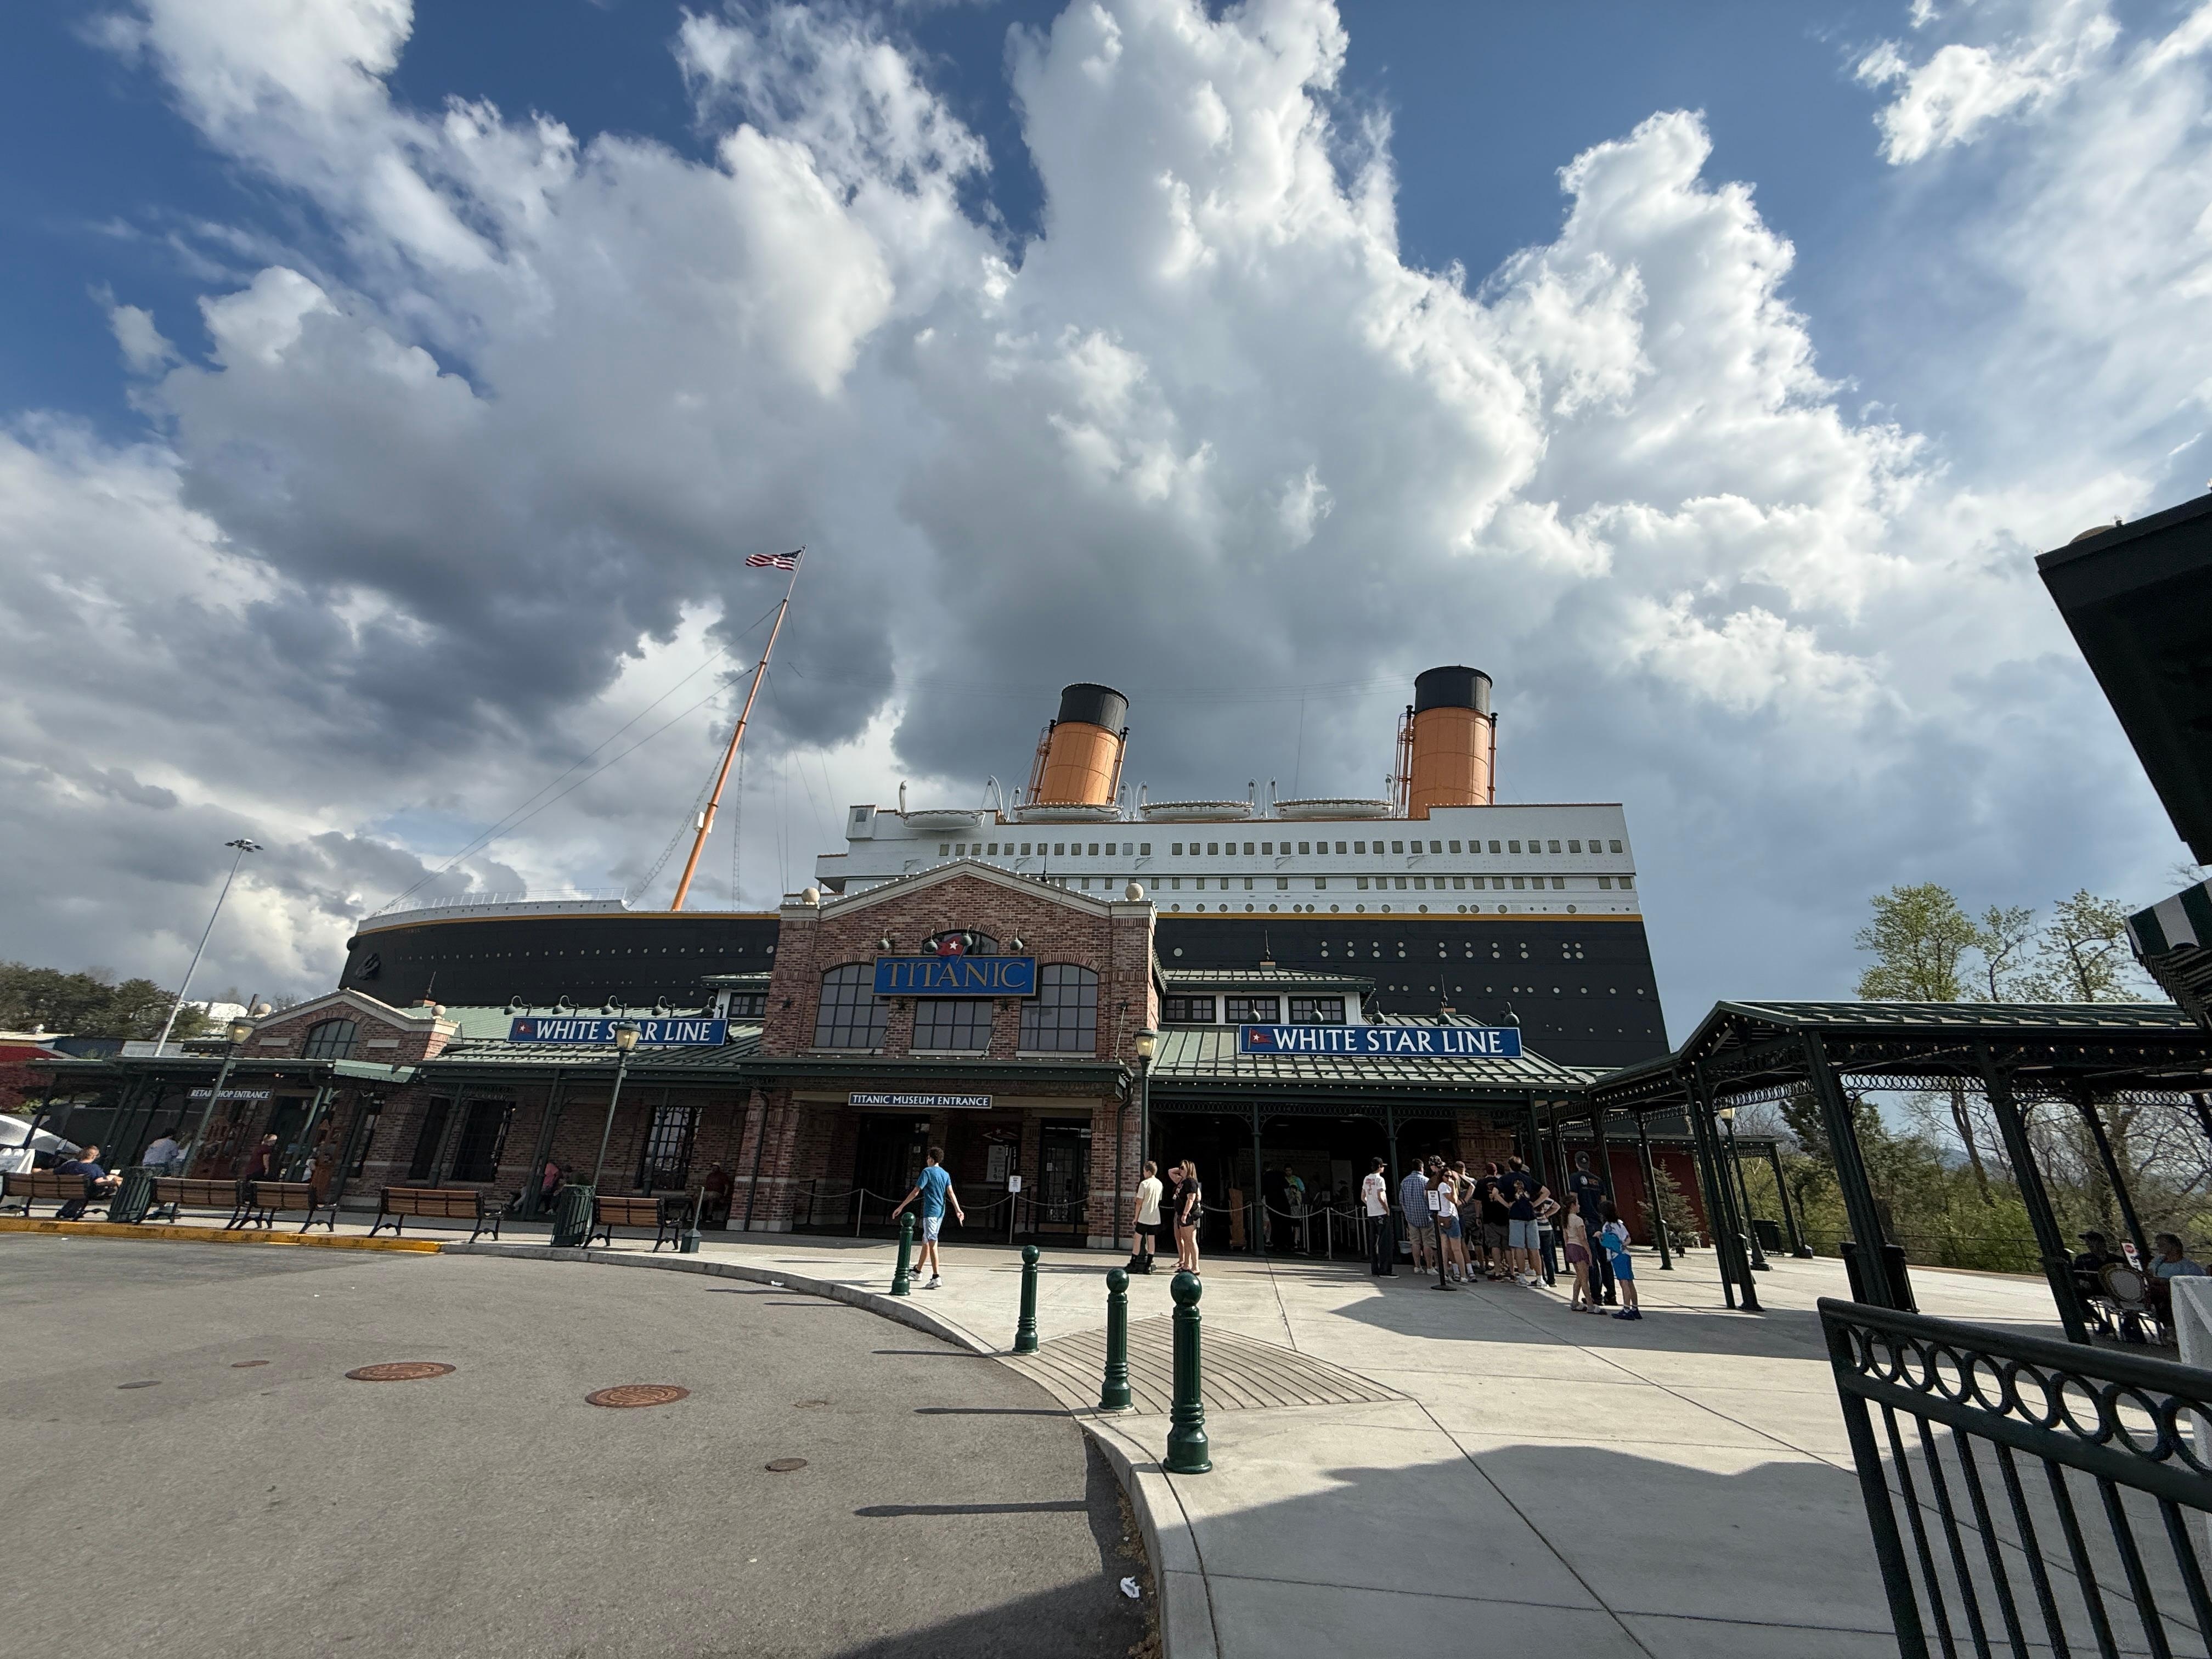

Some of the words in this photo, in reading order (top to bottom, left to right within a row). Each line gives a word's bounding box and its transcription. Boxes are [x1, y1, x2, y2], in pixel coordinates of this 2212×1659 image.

[884, 962, 1026, 988] TITANIC
[537, 1020, 601, 1040] WHITE
[606, 1021, 657, 1041] SR
[664, 1022, 712, 1041] LINE
[1272, 1028, 1358, 1051] WHITE
[1367, 1029, 1435, 1053] STAR
[1443, 1030, 1504, 1054] LINE
[234, 1090, 270, 1098] ENTRANCE
[853, 1094, 890, 1104] TITANIC
[893, 1096, 935, 1104] MUSEUM
[937, 1096, 989, 1106] ENTRANCE
